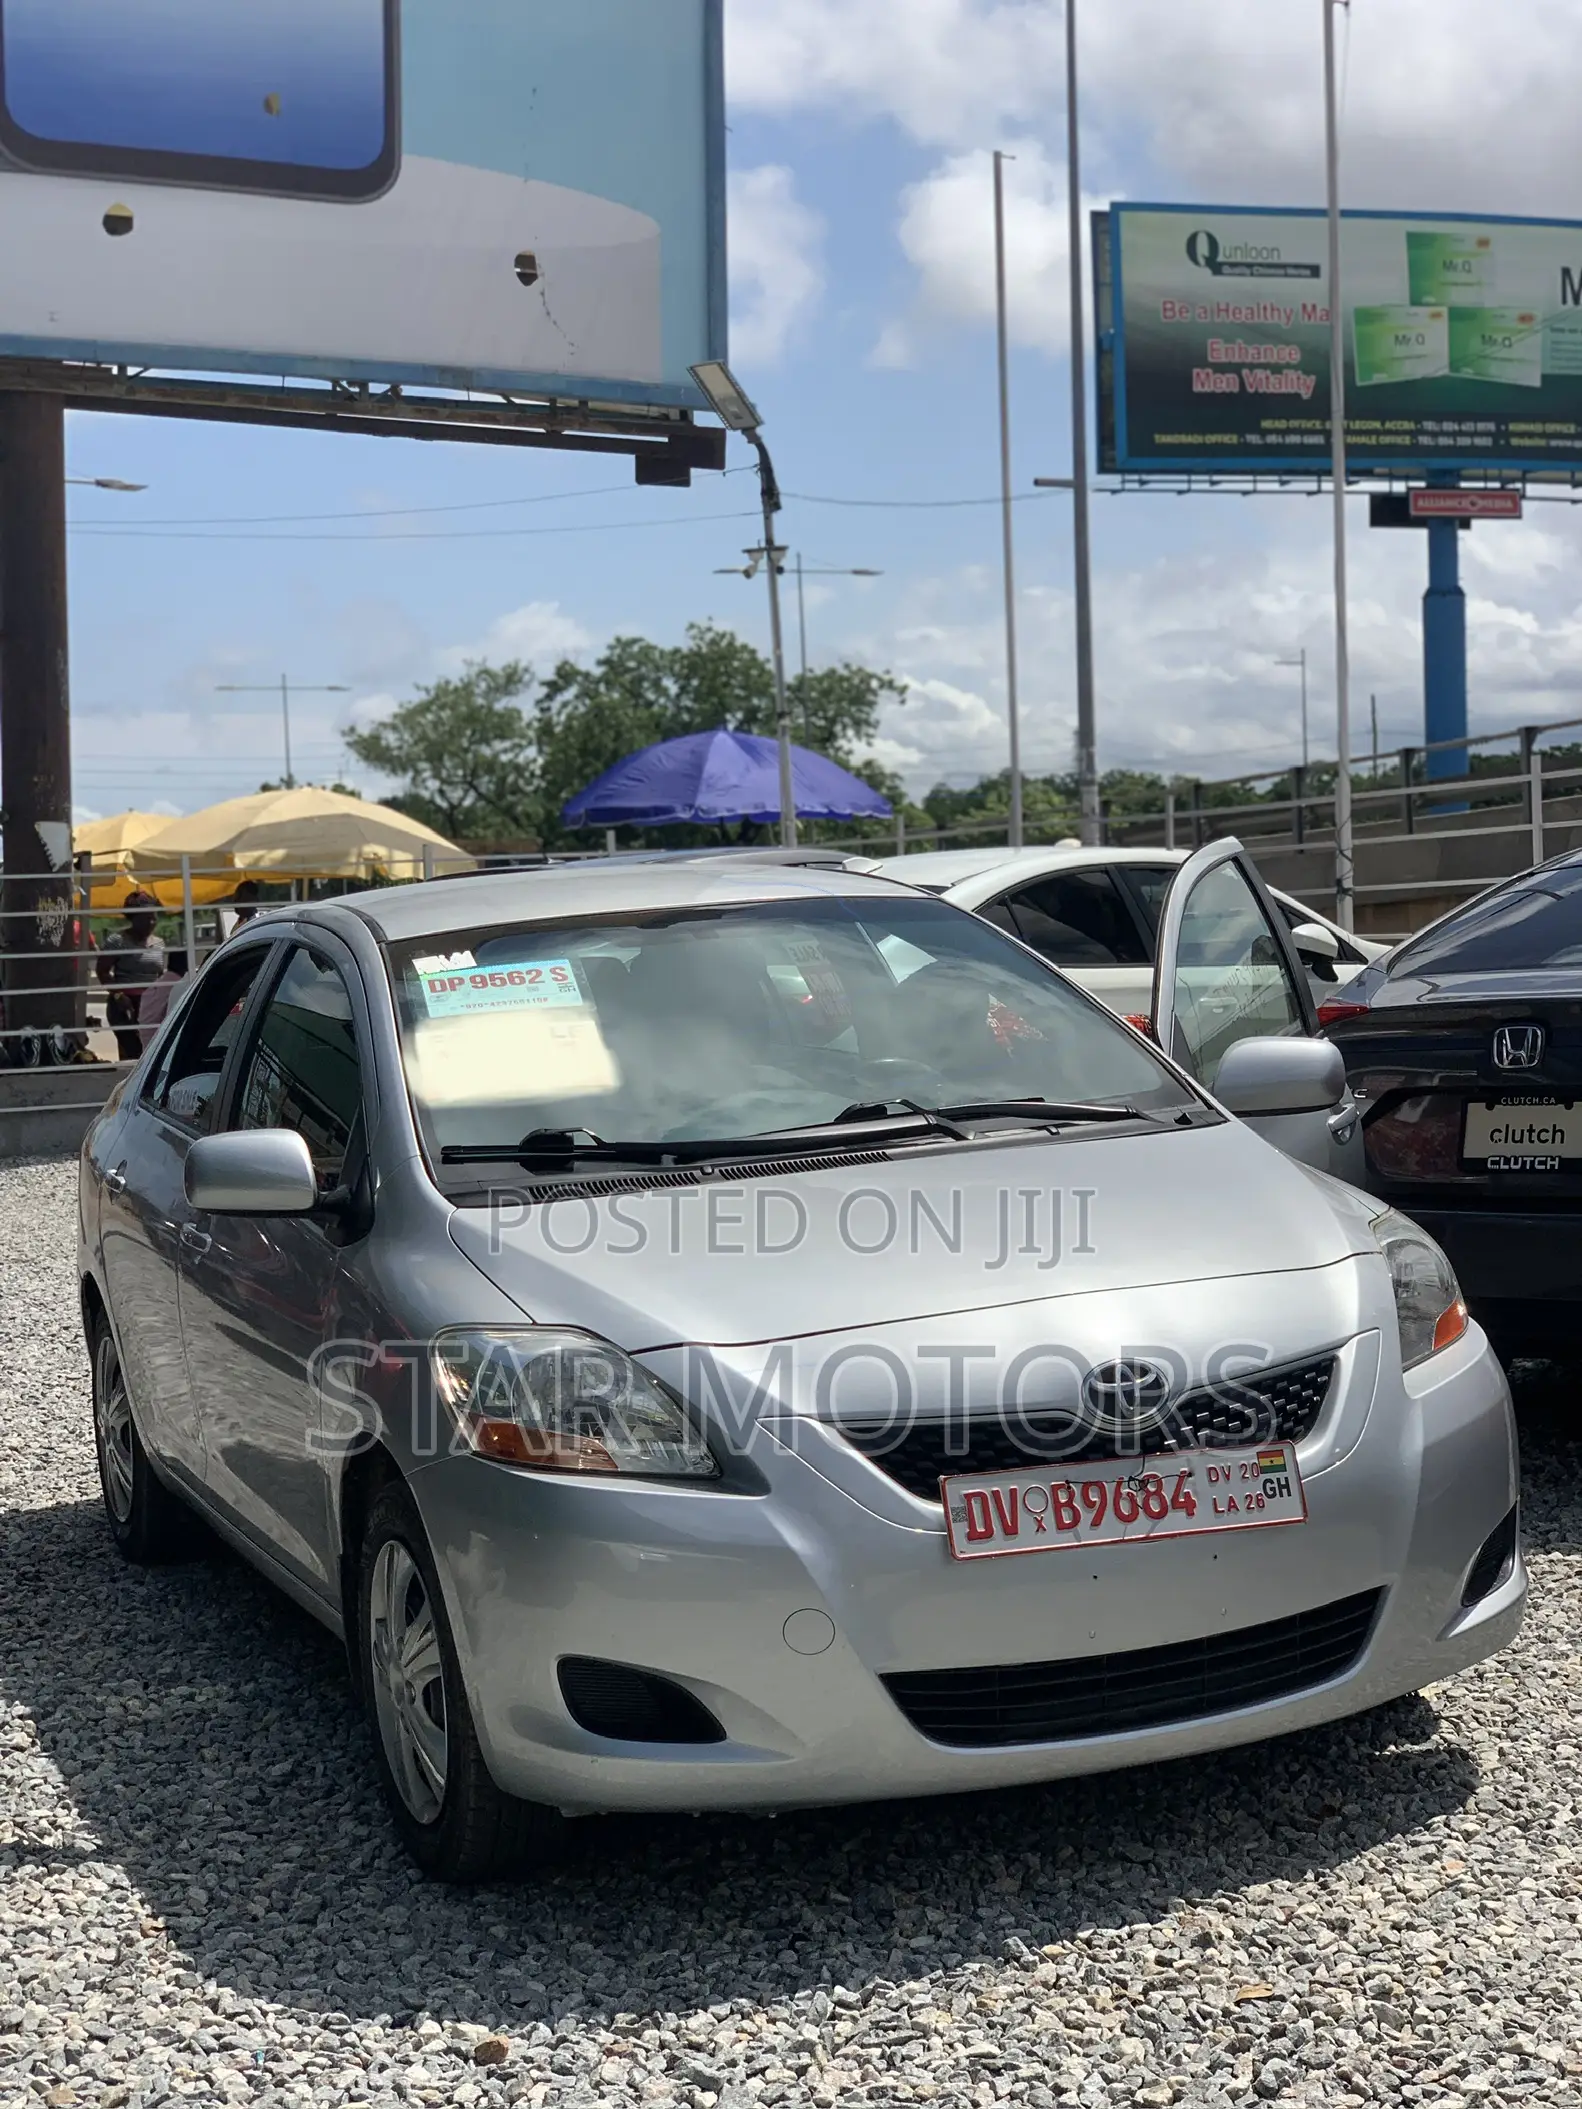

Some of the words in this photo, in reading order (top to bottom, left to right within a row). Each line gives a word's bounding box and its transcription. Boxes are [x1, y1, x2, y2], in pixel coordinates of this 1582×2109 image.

[1162, 300, 1189, 321] Be
[1198, 304, 1208, 320] a
[1215, 302, 1294, 326] Healthy
[1301, 303, 1332, 322] Ma
[1208, 340, 1299, 362] Enhance
[1193, 369, 1239, 391] Men
[1242, 370, 1316, 399] Vitality
[1343, 434, 1377, 445] AMALE
[428, 977, 465, 993] DP
[470, 969, 546, 989] 9562
[550, 966, 569, 982] S
[1500, 1096, 1556, 1105] CLUTCH.CA
[1489, 1124, 1565, 1144] clutch
[1486, 1156, 1559, 1170] CLUTCH
[1207, 1464, 1231, 1483] DV
[1240, 1462, 1260, 1479] 20
[1262, 1476, 1292, 1499] GH
[963, 1485, 1019, 1541] DV
[1051, 1469, 1197, 1531] B9684
[1212, 1494, 1240, 1514] LA
